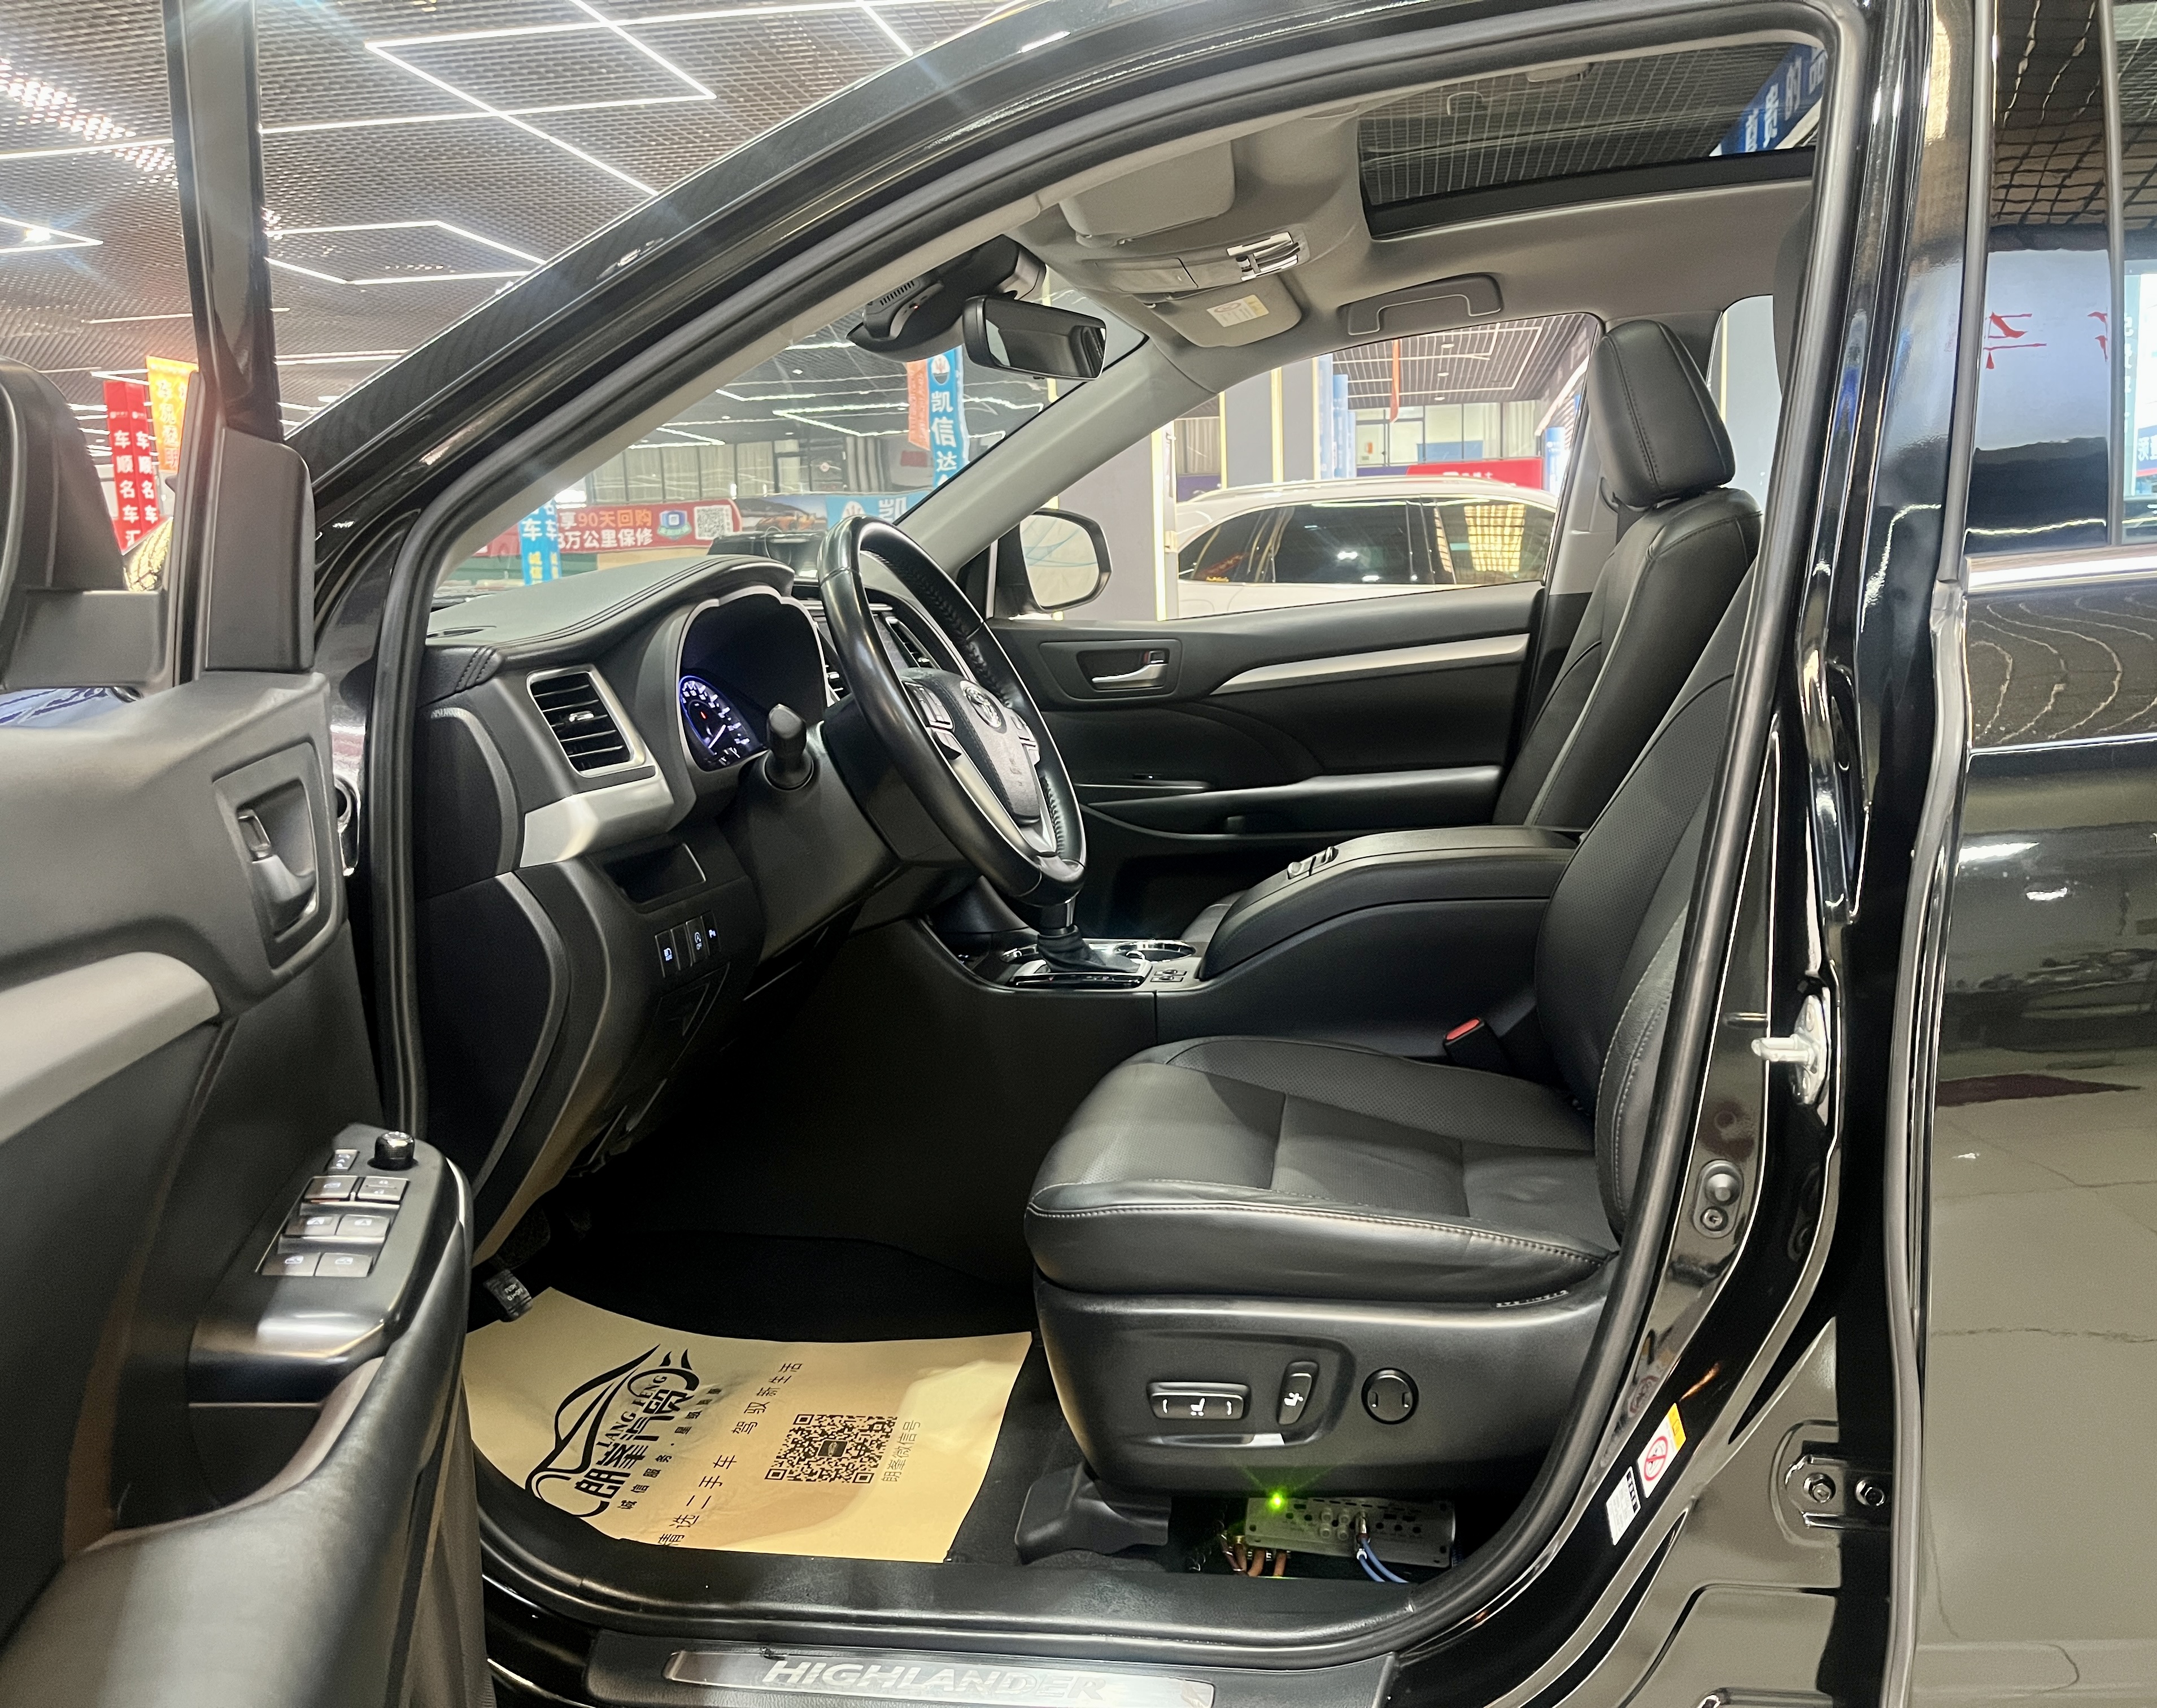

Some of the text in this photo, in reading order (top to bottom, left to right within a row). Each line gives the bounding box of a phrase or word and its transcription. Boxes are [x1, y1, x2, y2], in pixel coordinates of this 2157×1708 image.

[596, 1375, 668, 1448] LANG FENG
[657, 1363, 803, 1546] 精选二手车 驾驭新生活
[761, 1659, 1106, 1701] HIGHLANDER
